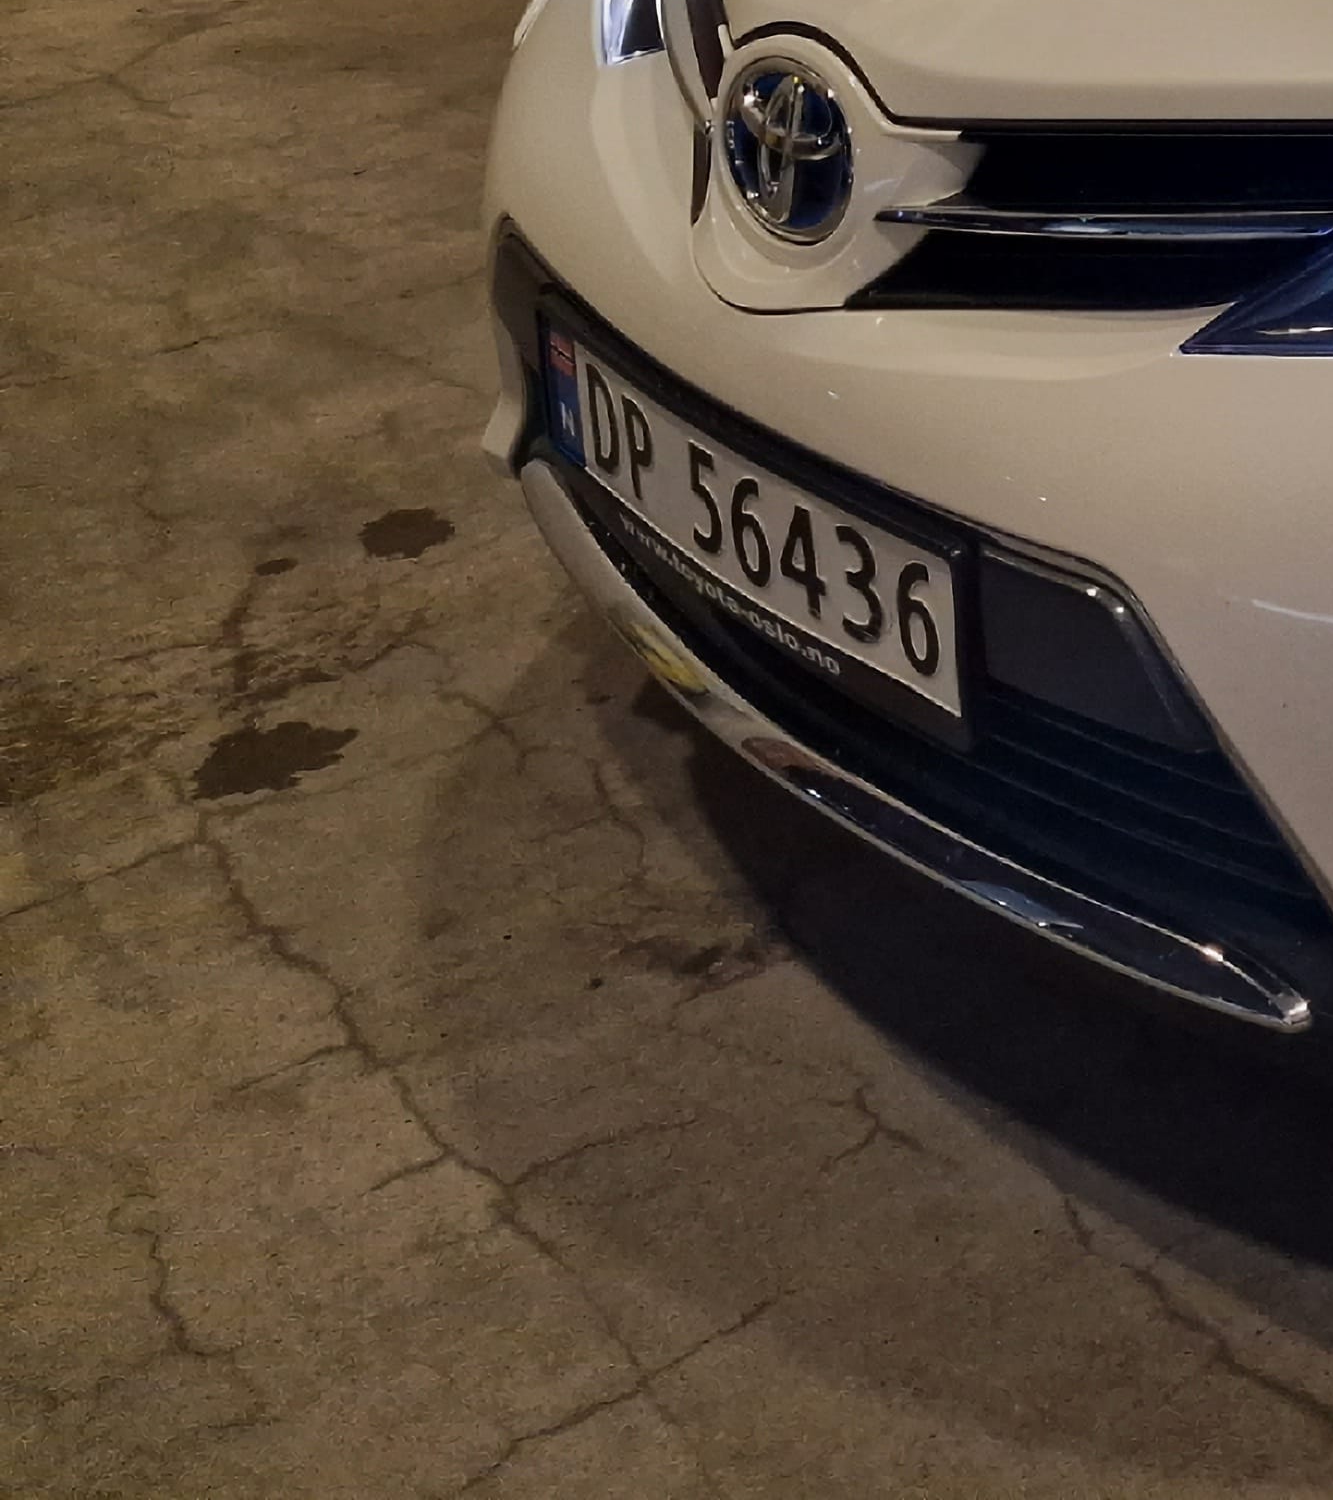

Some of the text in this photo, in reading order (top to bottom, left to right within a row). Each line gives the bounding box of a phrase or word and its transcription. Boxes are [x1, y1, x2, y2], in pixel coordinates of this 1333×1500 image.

[559, 401, 576, 437] N
[586, 362, 941, 677] DP 56436
